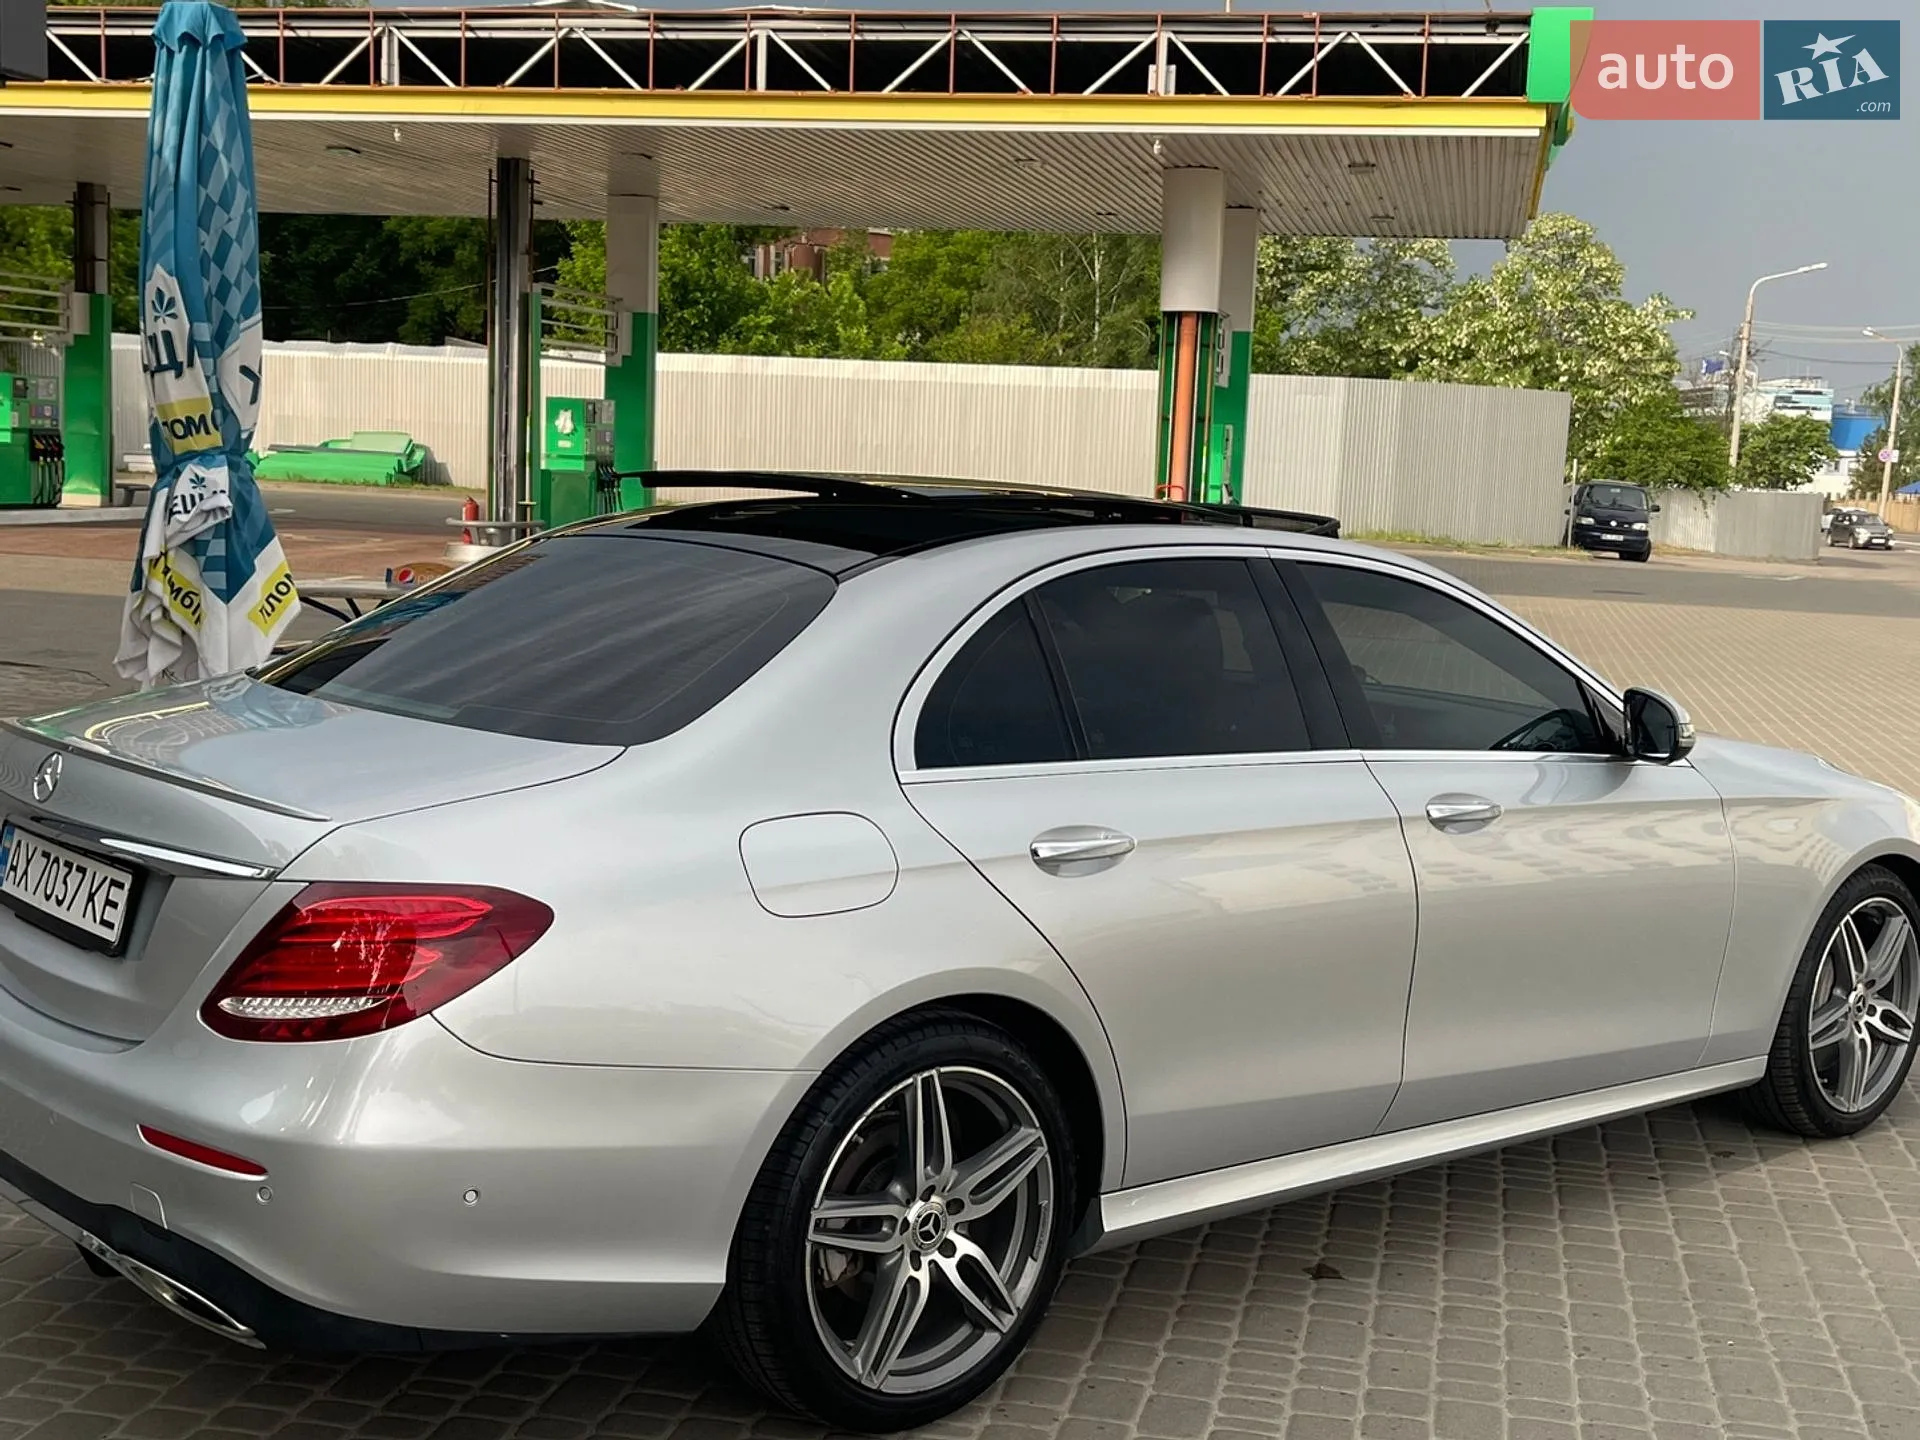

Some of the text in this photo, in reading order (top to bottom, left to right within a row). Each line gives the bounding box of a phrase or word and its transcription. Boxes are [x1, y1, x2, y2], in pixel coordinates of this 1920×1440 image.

[6, 839, 126, 931] AX 7037 KE
